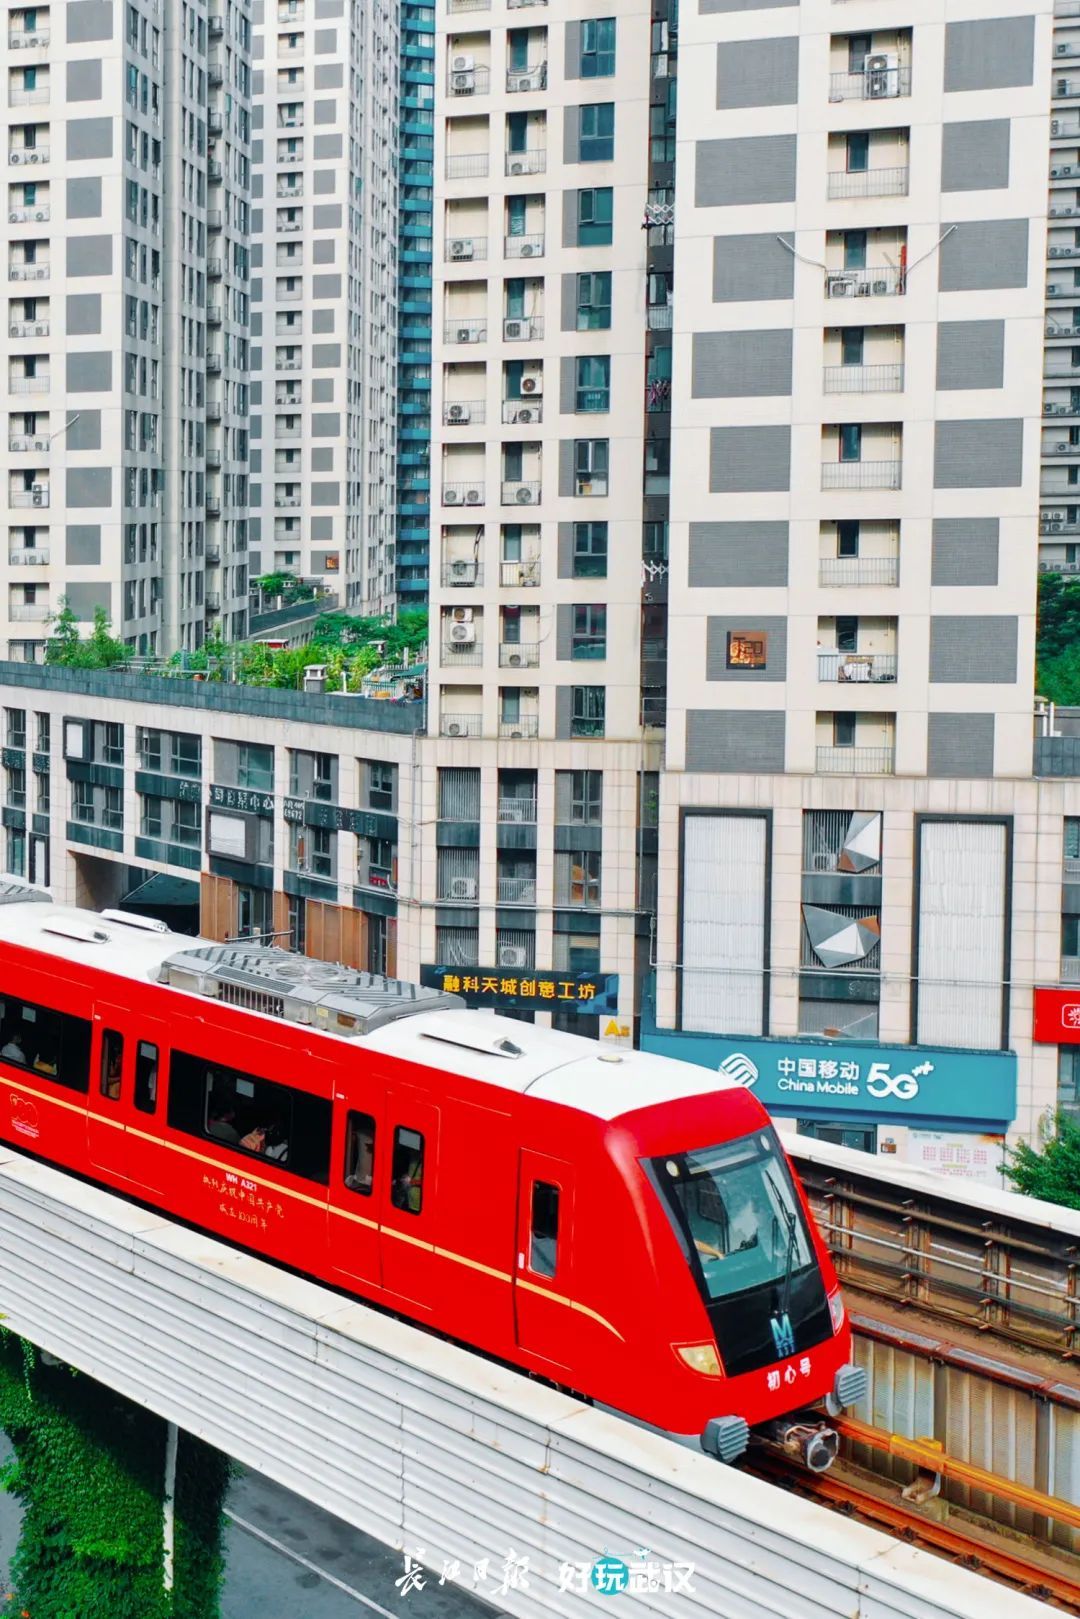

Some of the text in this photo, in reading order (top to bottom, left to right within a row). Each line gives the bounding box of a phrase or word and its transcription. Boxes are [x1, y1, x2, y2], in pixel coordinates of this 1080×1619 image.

[443, 974, 596, 1000] 融科天城创意工坊
[778, 1057, 859, 1080] 中国移动
[778, 1078, 859, 1095] China Mobile
[225, 1172, 238, 1184] WH
[767, 1357, 812, 1391] 初心号
